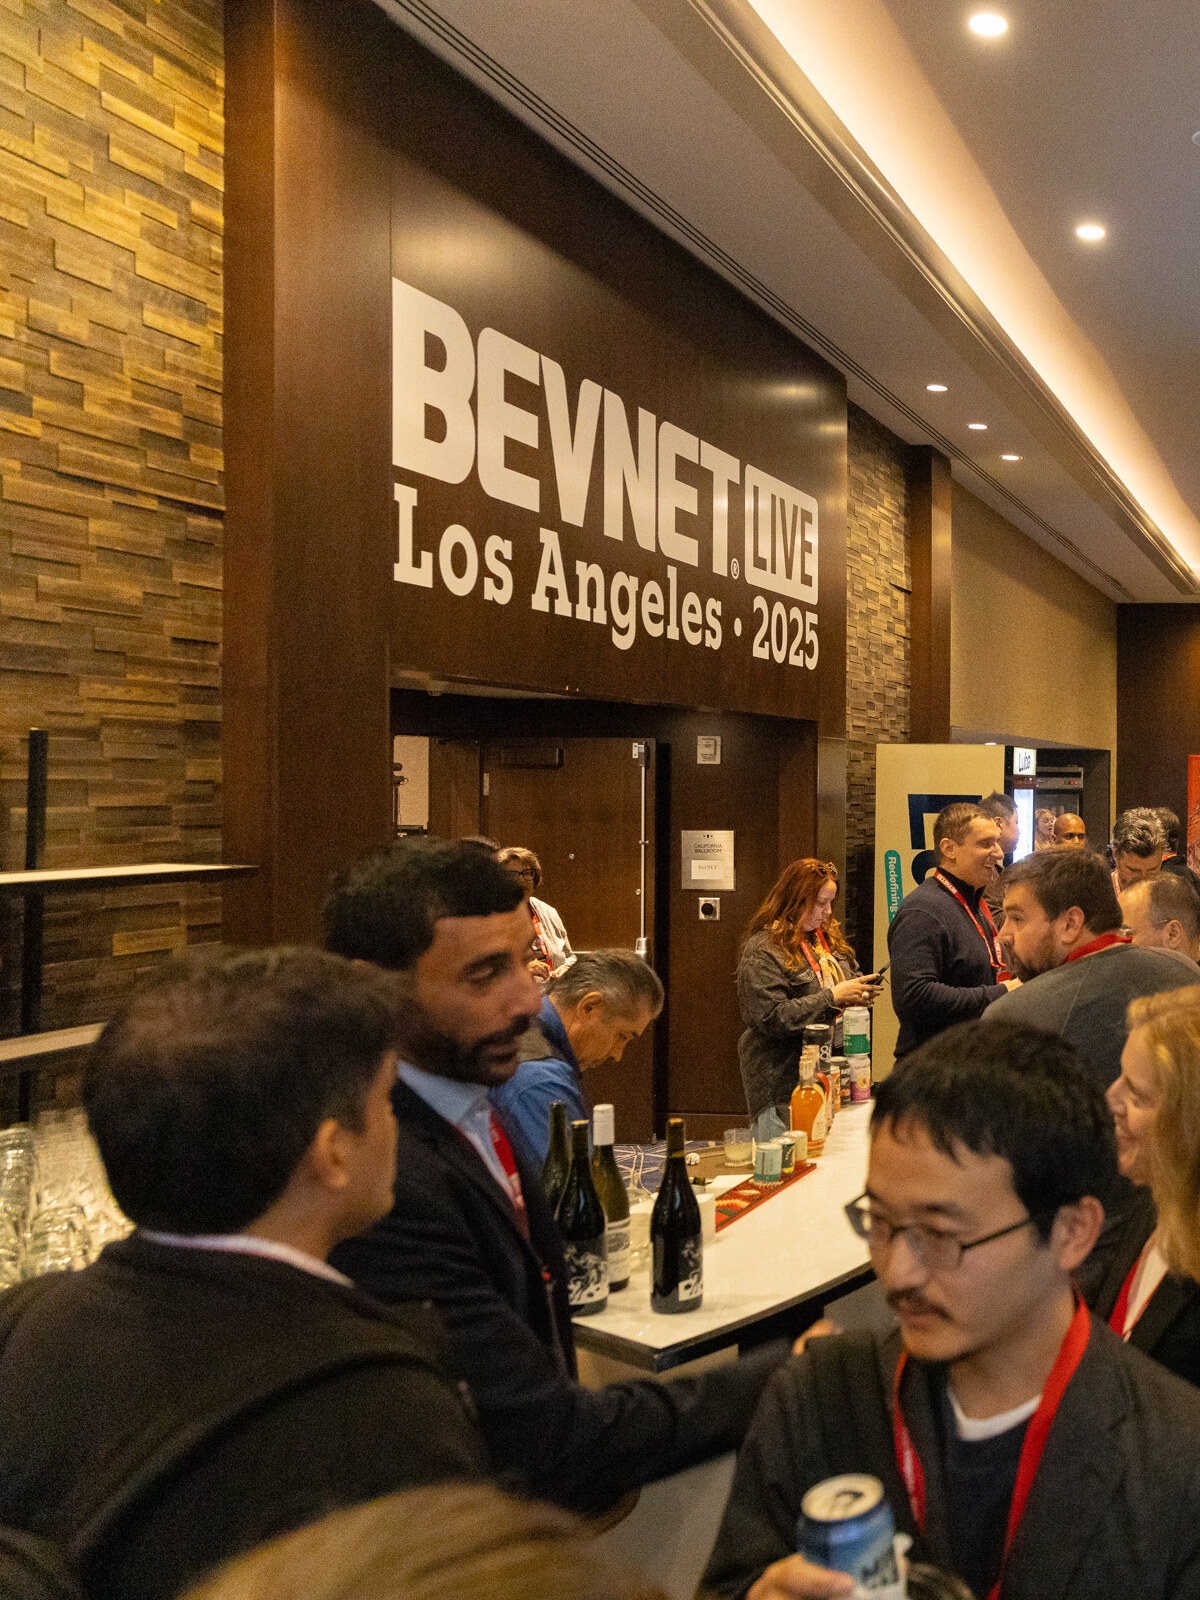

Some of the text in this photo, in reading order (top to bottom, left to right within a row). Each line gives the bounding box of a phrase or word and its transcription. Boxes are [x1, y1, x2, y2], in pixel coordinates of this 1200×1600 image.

[392, 276, 815, 590] BEVNET LIVE
[393, 482, 819, 671] Los Angeles 2025
[887, 856, 900, 913] Redefining
